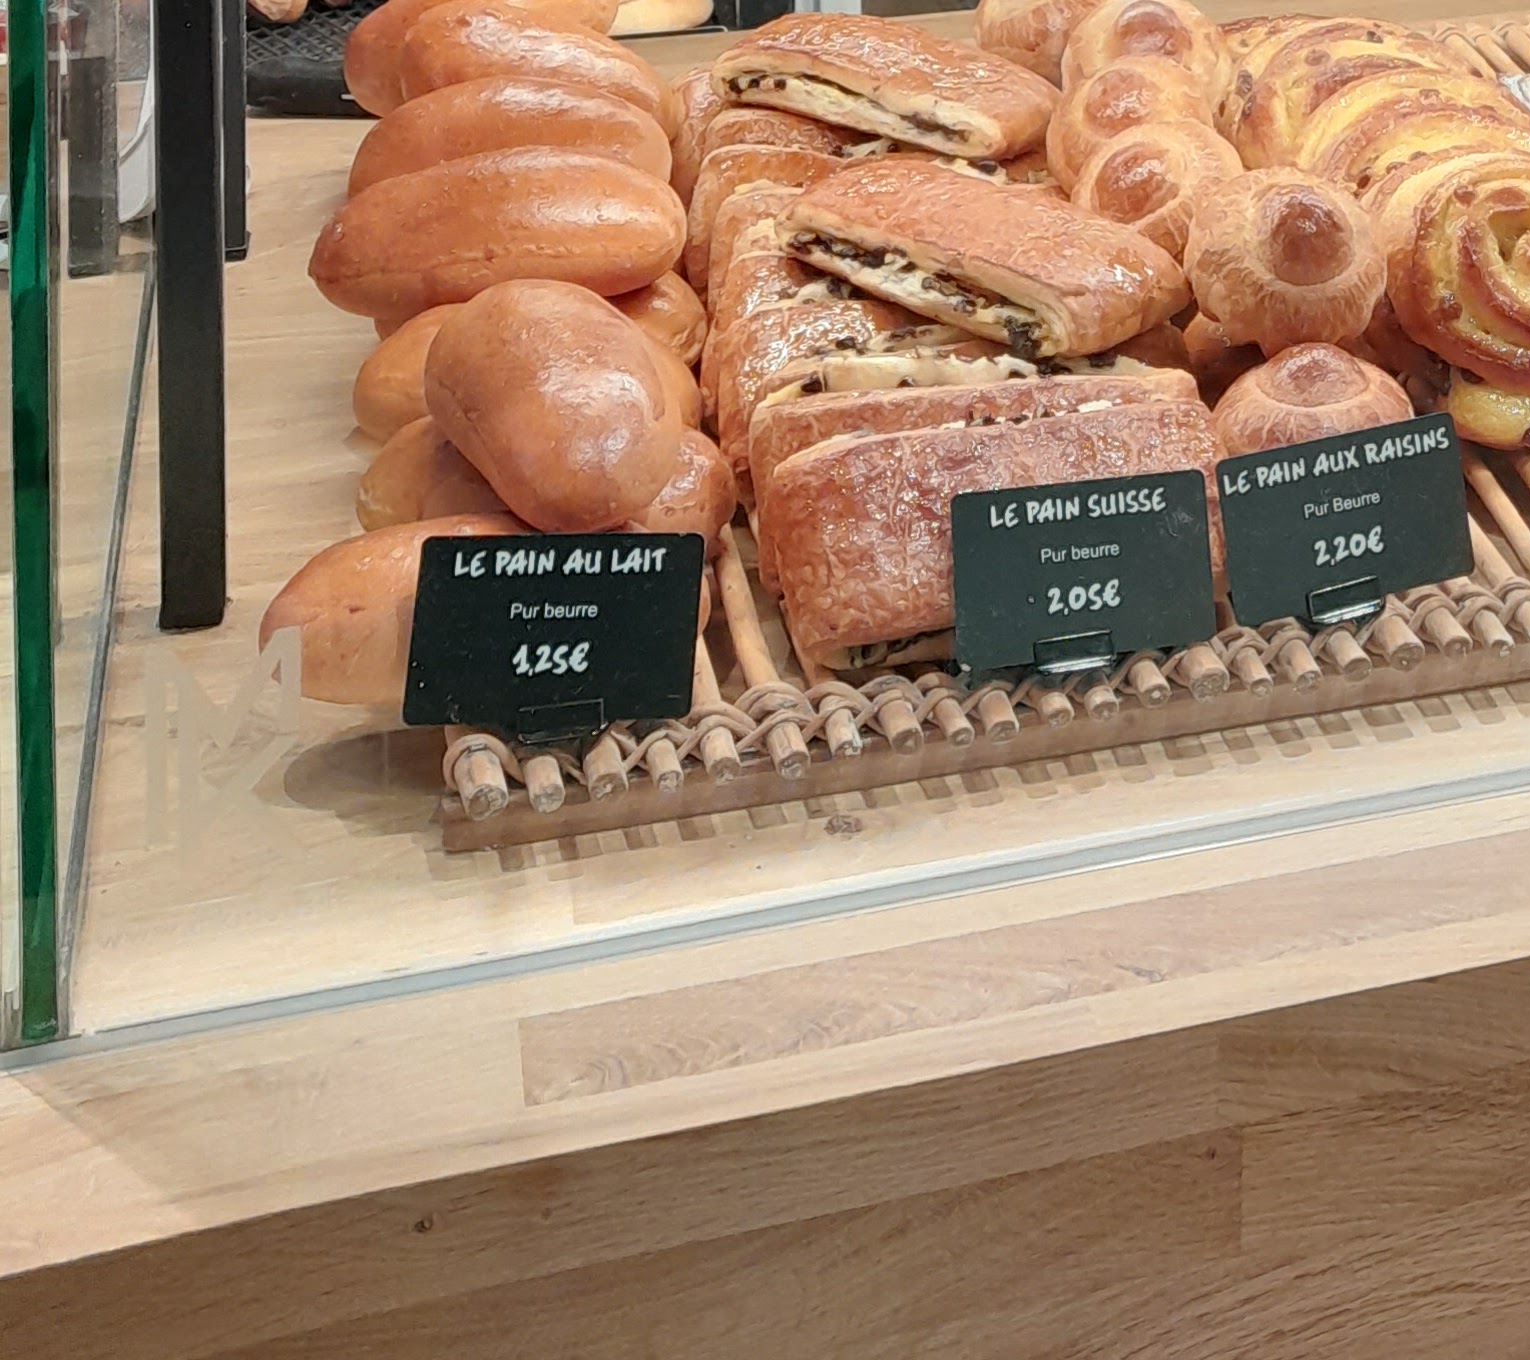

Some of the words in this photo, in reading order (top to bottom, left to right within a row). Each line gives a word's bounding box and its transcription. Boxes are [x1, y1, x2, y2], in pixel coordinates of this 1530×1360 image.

[1223, 469, 1251, 496] LE
[1256, 457, 1306, 488] PAIN
[1313, 445, 1360, 477] AUX
[1364, 426, 1450, 464] RAISINS
[989, 502, 1019, 528] LE
[1026, 495, 1080, 524] PAIN
[1087, 487, 1167, 518] SUISSE
[1303, 500, 1330, 520] Pur
[1332, 491, 1381, 513] Beurre
[454, 550, 487, 578] LE
[495, 549, 555, 576] PAIN
[562, 548, 602, 575] AU
[610, 547, 667, 573] LAIT
[1040, 547, 1066, 564] Pur
[1071, 542, 1120, 561] beurre
[1313, 525, 1385, 567] 2,20€
[510, 603, 540, 620] Pur
[544, 602, 599, 619] beurre
[1047, 578, 1122, 616] 2,05€
[512, 641, 591, 677] 1,25€
